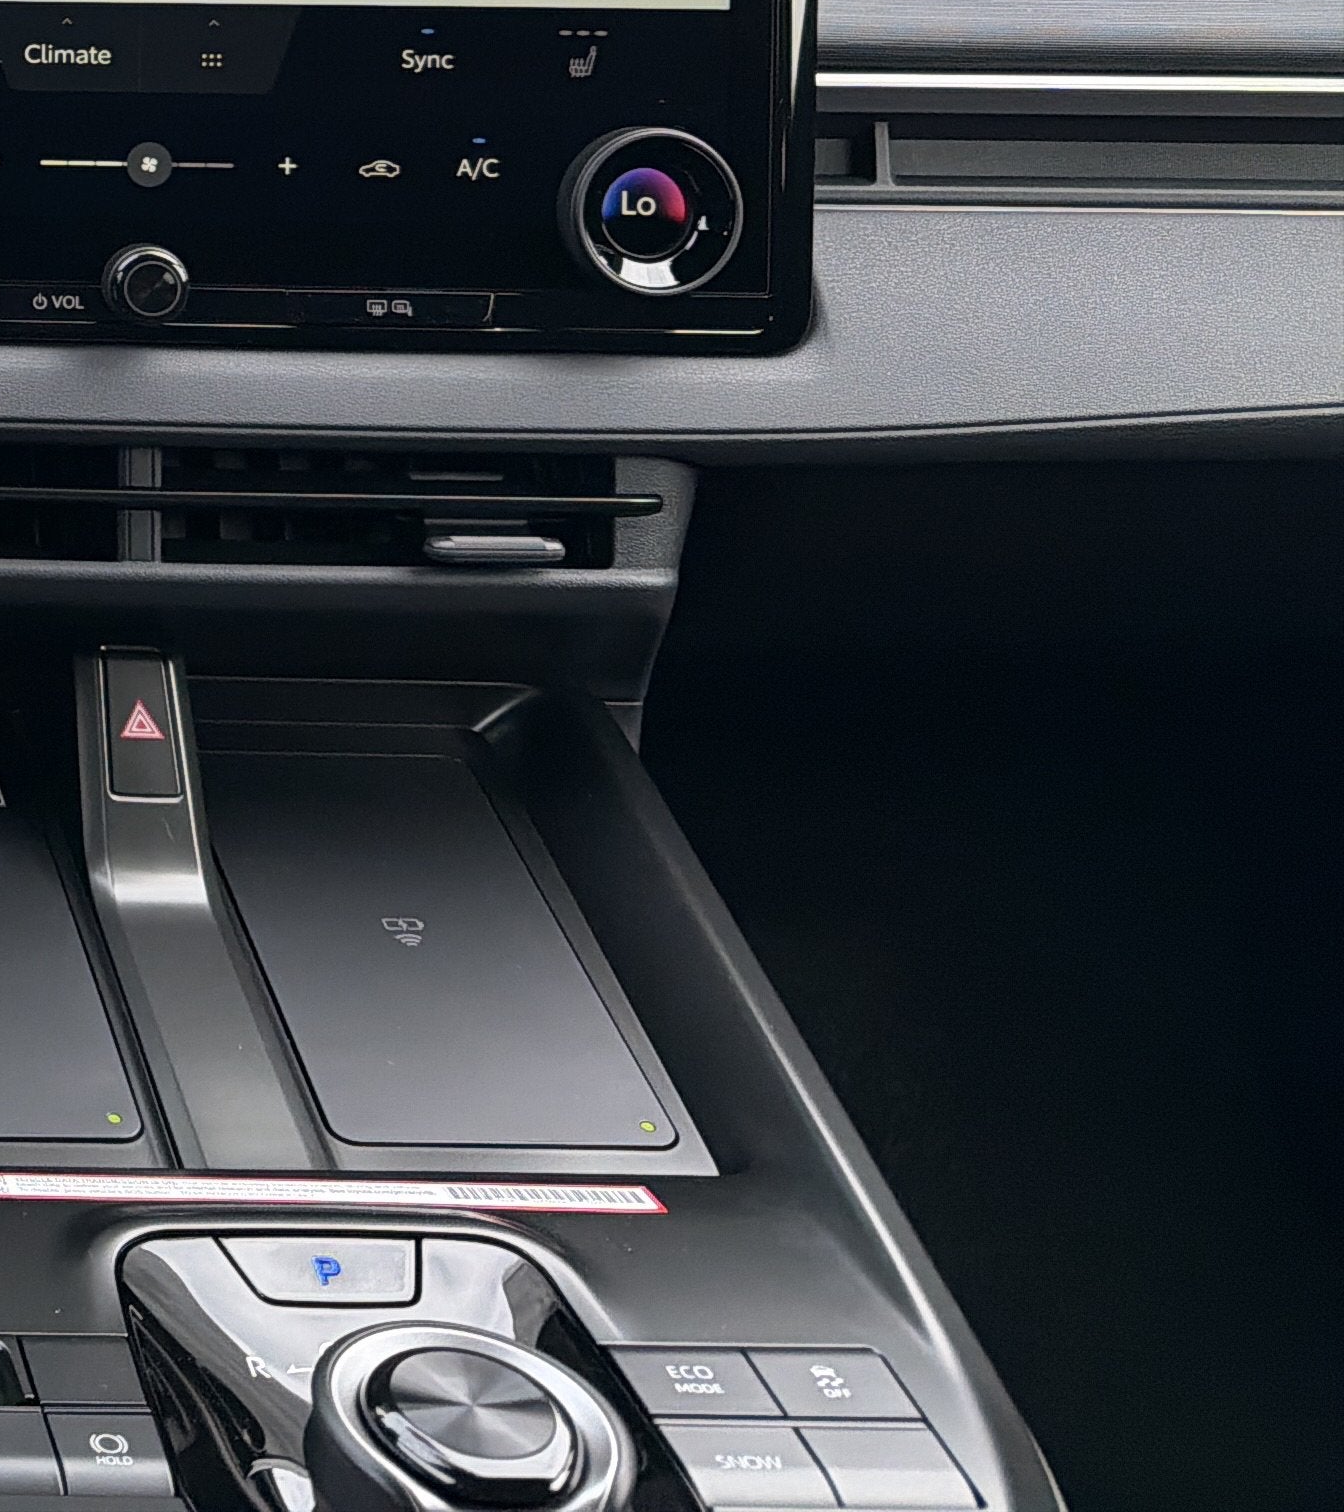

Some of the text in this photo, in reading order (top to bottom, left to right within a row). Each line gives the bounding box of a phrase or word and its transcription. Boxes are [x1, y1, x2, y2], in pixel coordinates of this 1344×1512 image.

[24, 44, 112, 66] Climate
[401, 49, 454, 72] Sync
[456, 157, 500, 180] A/C
[620, 190, 656, 216] Lo
[52, 295, 85, 310] VOL
[312, 1255, 342, 1286] P
[245, 1356, 272, 1379] R
[665, 1365, 714, 1380] ECO
[674, 1382, 725, 1394] MODE
[824, 1388, 852, 1399] OFF
[96, 1455, 134, 1467] HOLD
[714, 1454, 782, 1470] SNOW
